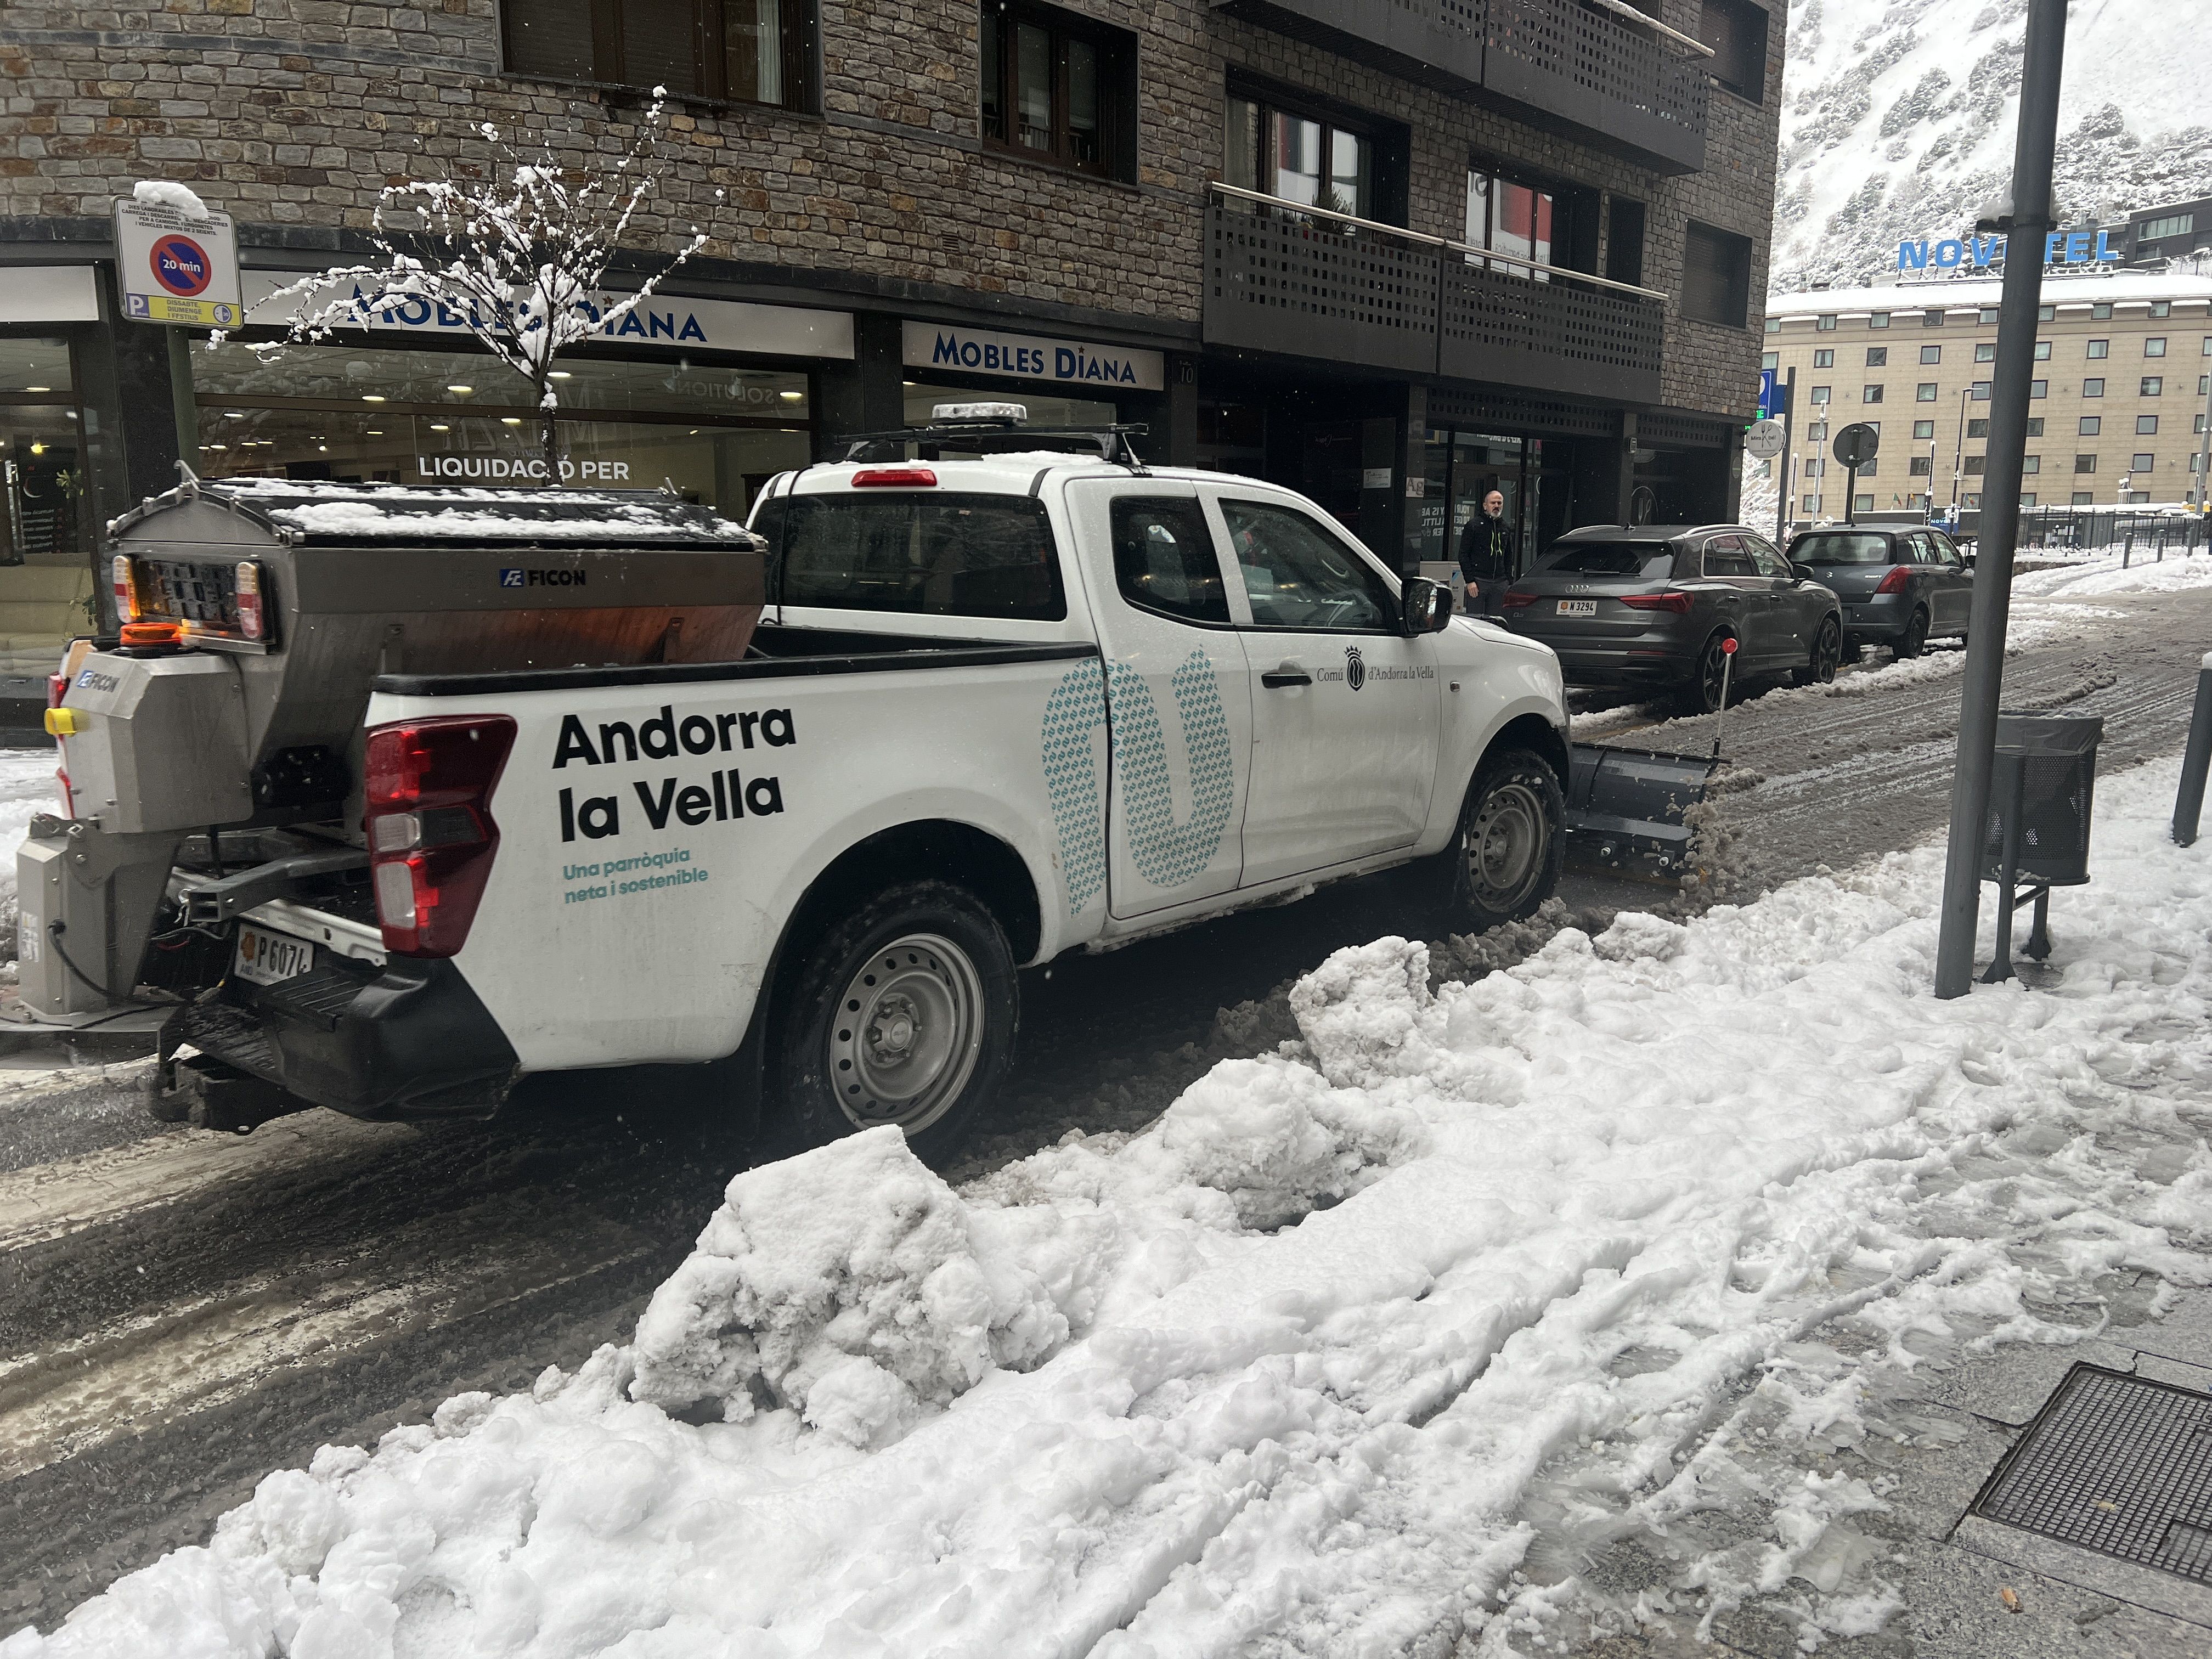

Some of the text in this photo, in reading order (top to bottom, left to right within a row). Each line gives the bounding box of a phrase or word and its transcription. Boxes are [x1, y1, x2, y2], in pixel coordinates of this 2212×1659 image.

[1898, 230, 2119, 269] NOVTEL
[162, 258, 201, 273] 20 min
[129, 296, 144, 315] P
[167, 306, 202, 314] DIUMENGE
[932, 330, 1044, 375] MOBLES
[1181, 366, 1193, 383] 10
[419, 454, 630, 481] LIQUIDACÓ PER
[528, 569, 586, 586] FICON
[1576, 602, 1594, 611] 3294
[1317, 667, 1343, 682] Comú
[551, 704, 797, 769] Andorra
[558, 768, 785, 843] la Vella
[563, 848, 690, 880] Una parròquia
[565, 867, 709, 904] neta i sostenible
[257, 936, 267, 967] P
